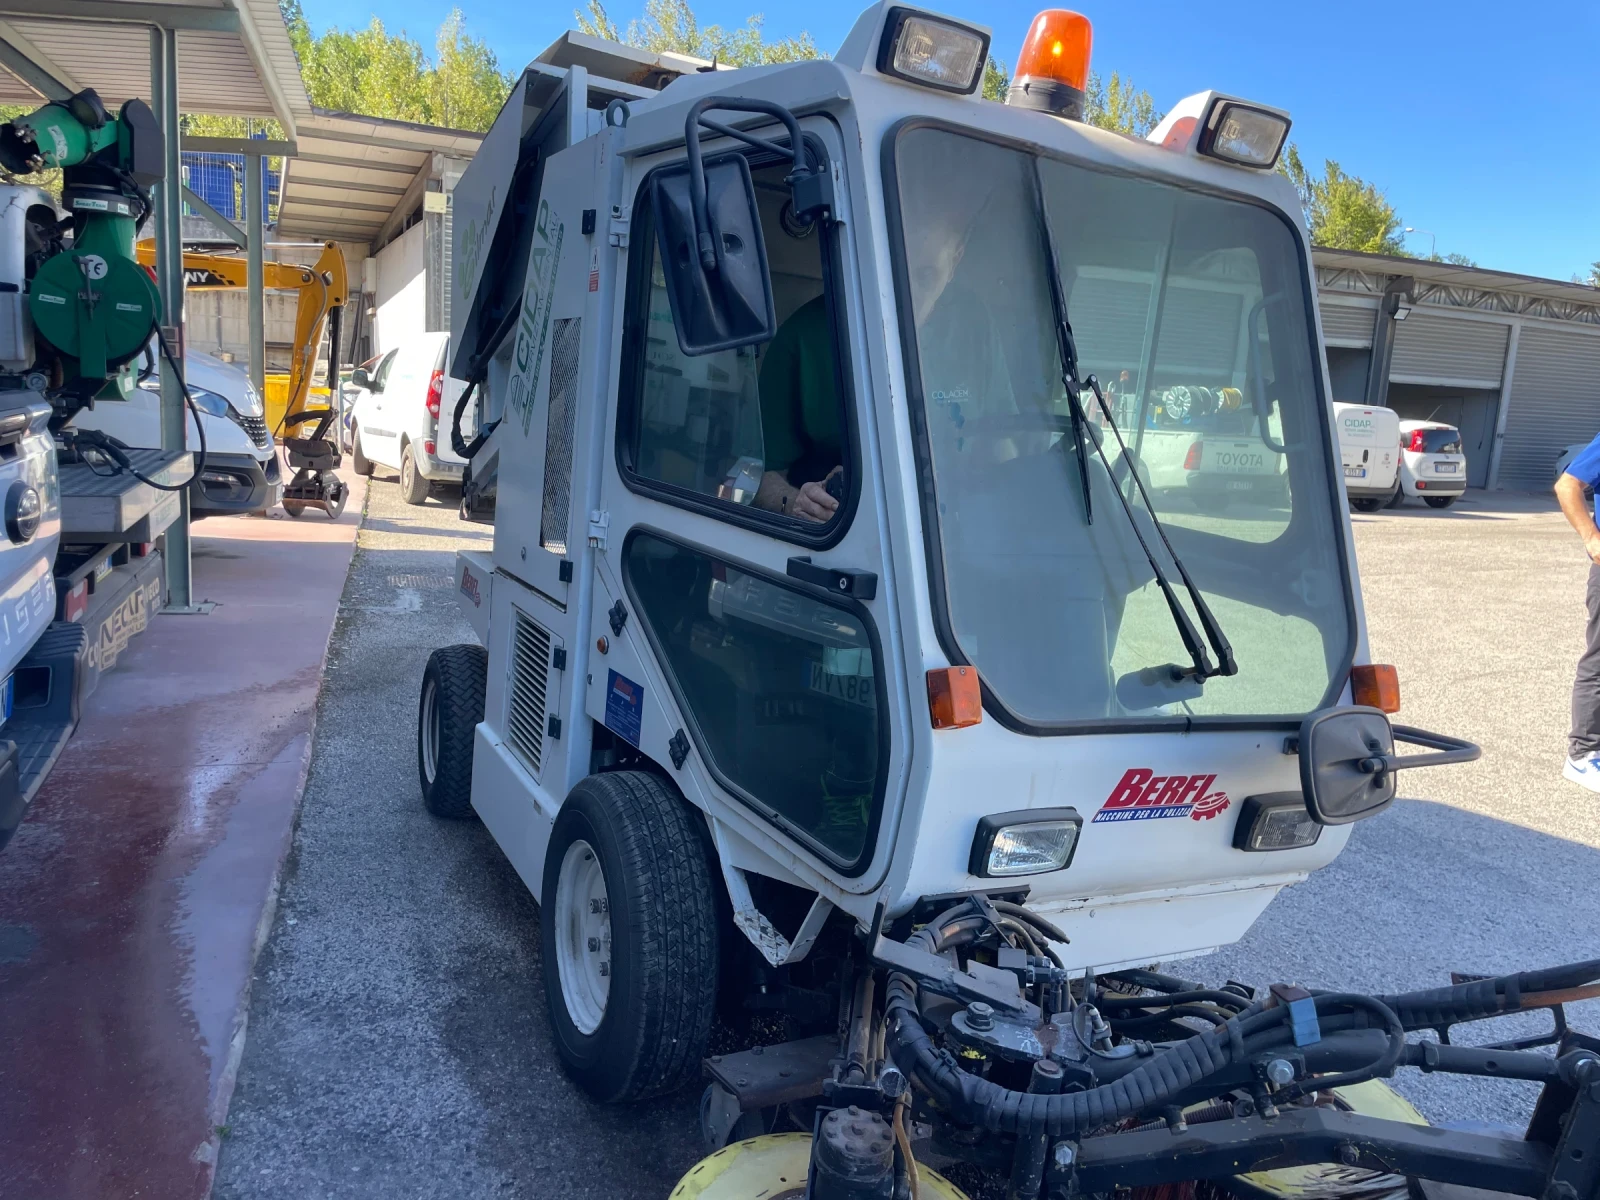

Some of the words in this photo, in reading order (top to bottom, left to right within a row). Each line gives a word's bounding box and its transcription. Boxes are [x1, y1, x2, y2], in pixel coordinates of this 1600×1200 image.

[517, 199, 549, 373] CIDAP
[1344, 418, 1371, 428] CIDAP
[1215, 452, 1263, 466] TOYOTA
[1094, 811, 1134, 822] MACCHINE
[1134, 810, 1151, 819] PER
[1151, 809, 1160, 818] LA
[1162, 807, 1192, 817] PULIZIA
